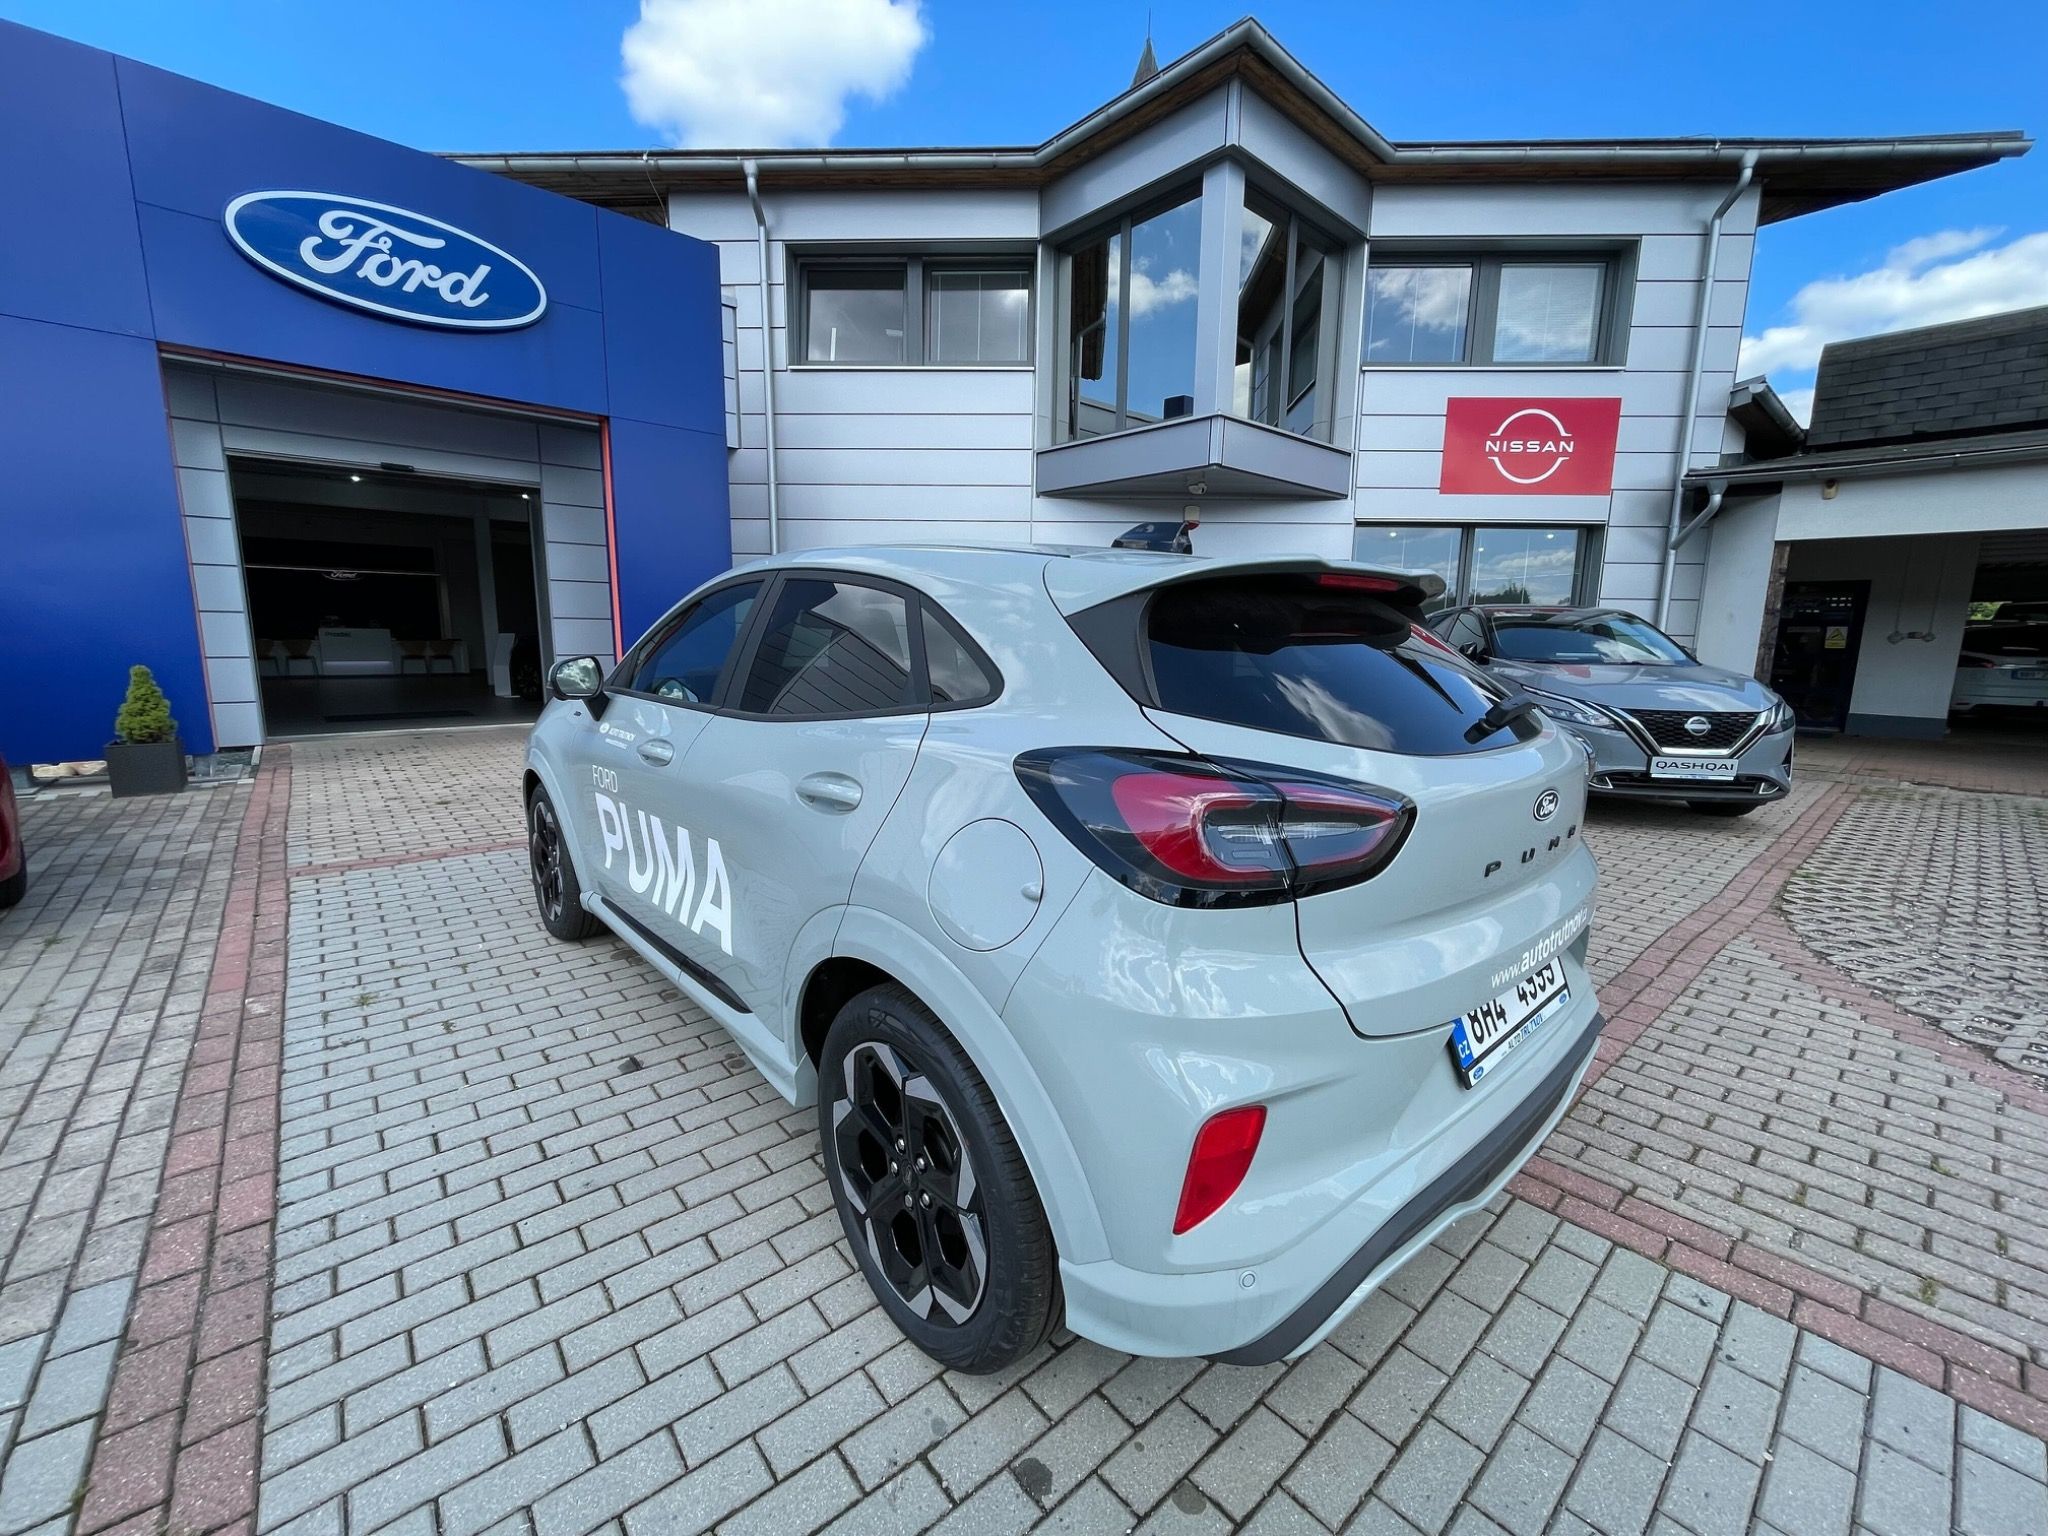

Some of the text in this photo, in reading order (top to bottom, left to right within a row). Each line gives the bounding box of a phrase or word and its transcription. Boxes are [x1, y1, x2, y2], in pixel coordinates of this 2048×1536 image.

[300, 210, 491, 308] Ford
[1485, 440, 1574, 453] NISSAN
[592, 764, 618, 793] FORD
[1656, 761, 1734, 772] QASHQAI
[595, 791, 733, 957] PUMA
[1467, 998, 1507, 1044] 8H4
[1458, 1040, 1471, 1058] CZ
